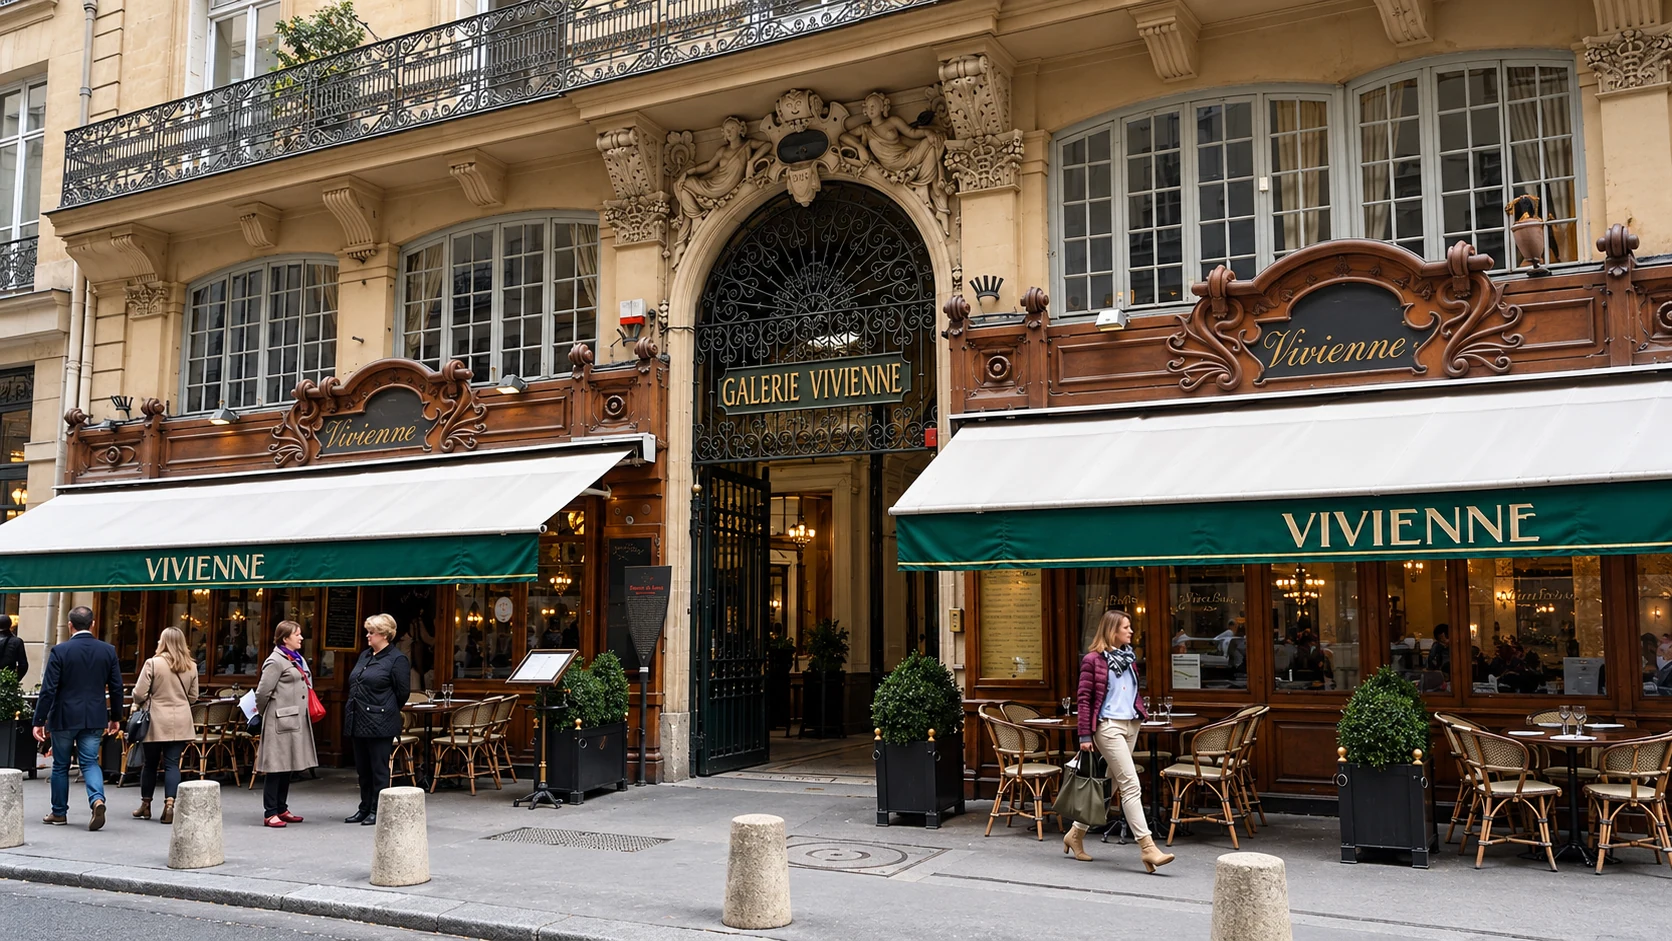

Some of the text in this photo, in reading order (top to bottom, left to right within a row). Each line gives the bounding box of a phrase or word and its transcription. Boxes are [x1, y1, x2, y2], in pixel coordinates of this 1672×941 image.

[1263, 328, 1406, 368] Vivienne
[722, 362, 903, 407] GALERIE VIVIENNE
[325, 419, 416, 448] Vivienne
[1281, 503, 1540, 548] VIVIENNE
[145, 553, 265, 581] VIVIENNE
